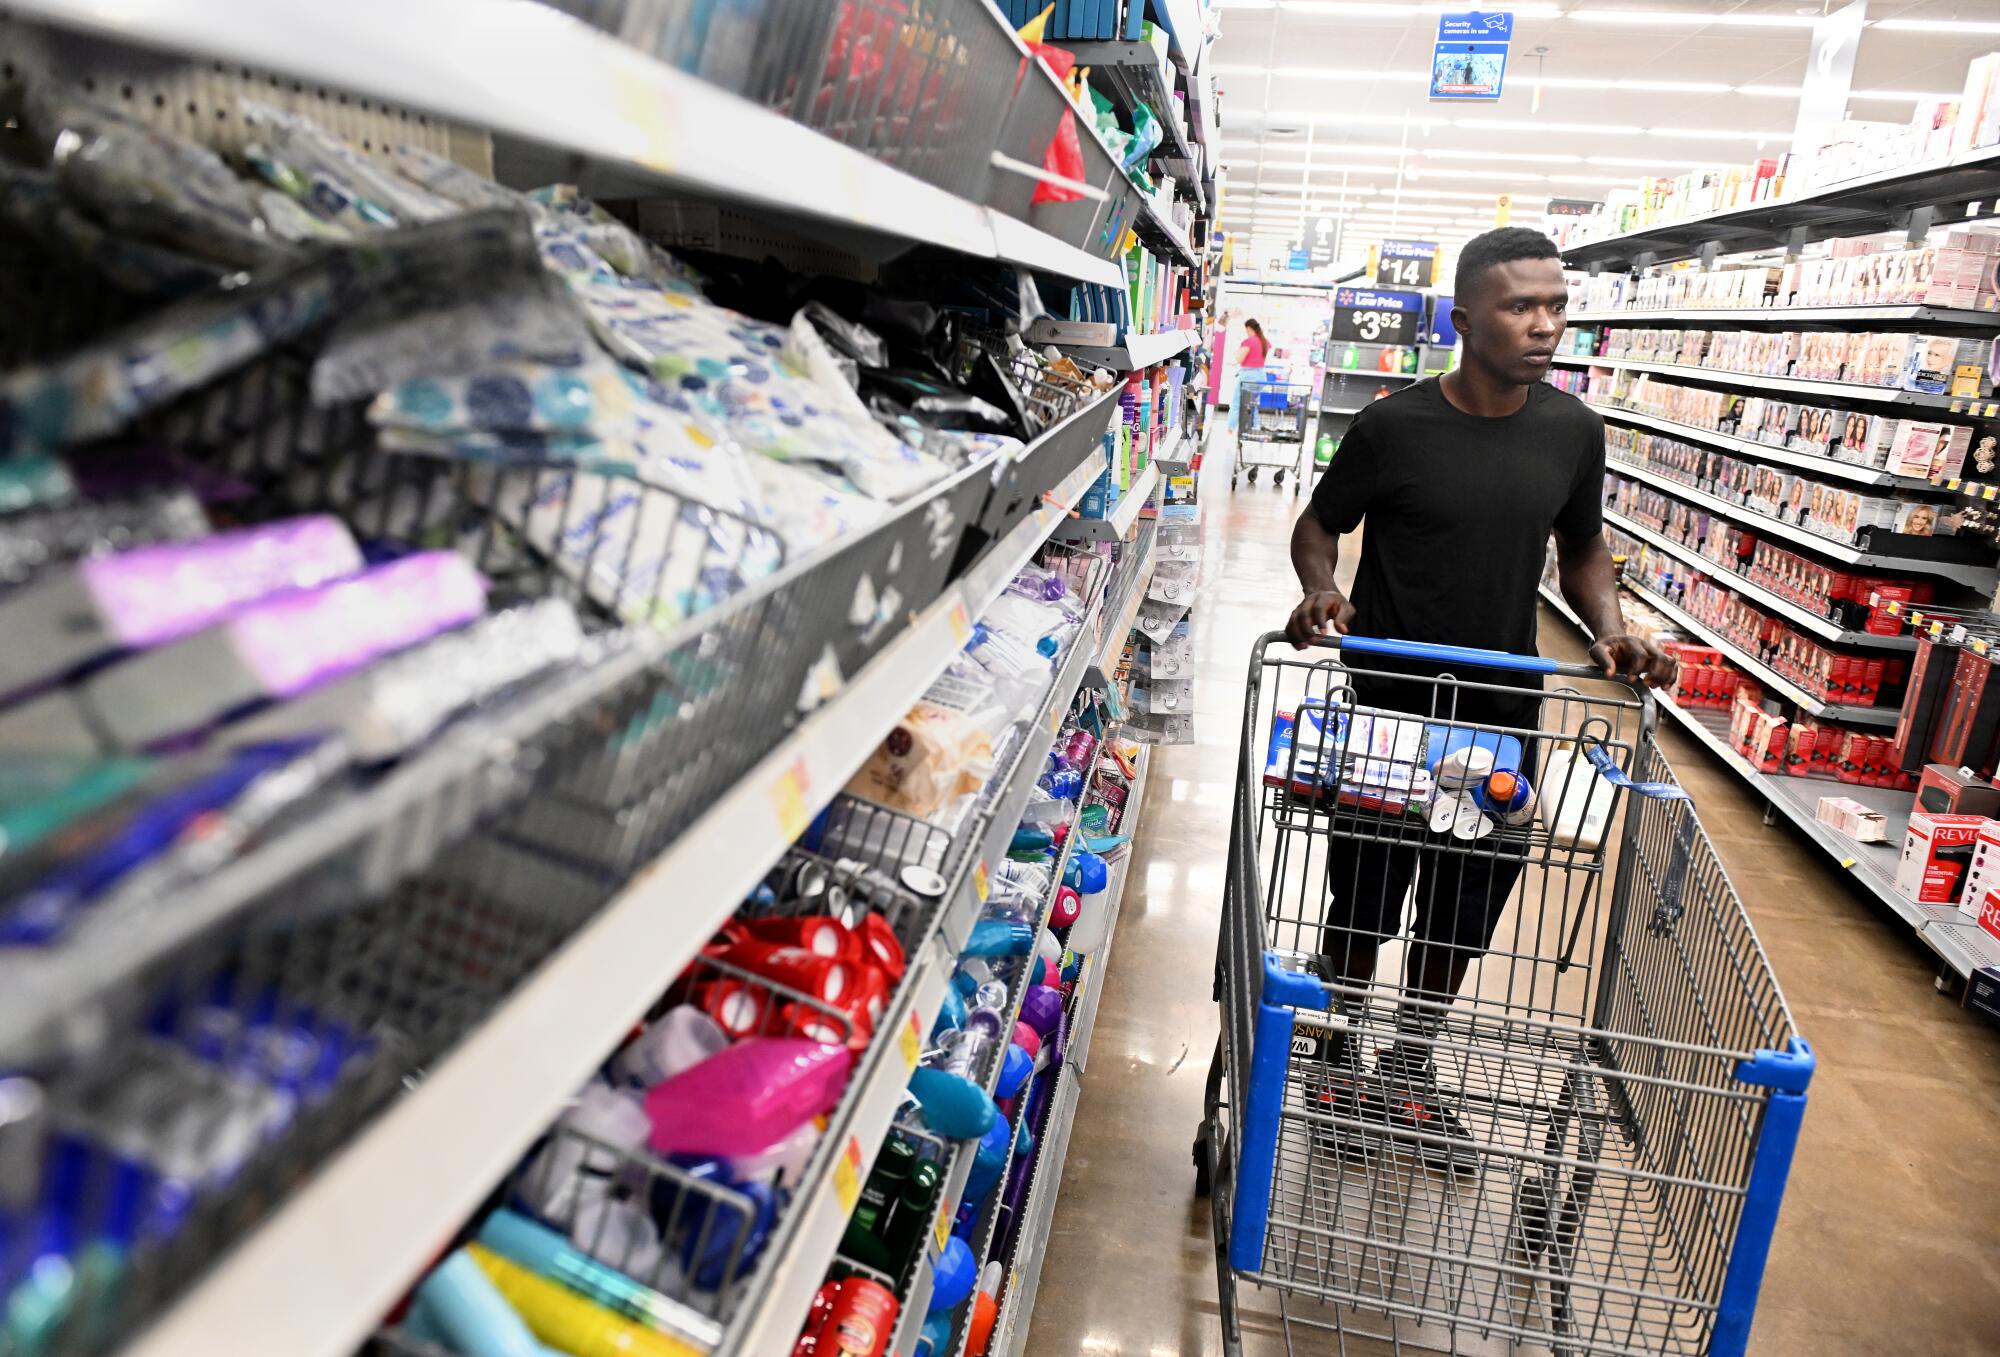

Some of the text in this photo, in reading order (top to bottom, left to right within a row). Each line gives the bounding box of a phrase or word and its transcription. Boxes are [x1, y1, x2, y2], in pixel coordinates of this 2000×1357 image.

[1444, 20, 1471, 28] Security
[1380, 258, 1420, 285] $14
[1355, 291, 1377, 306] Low
[1377, 297, 1404, 309] Price
